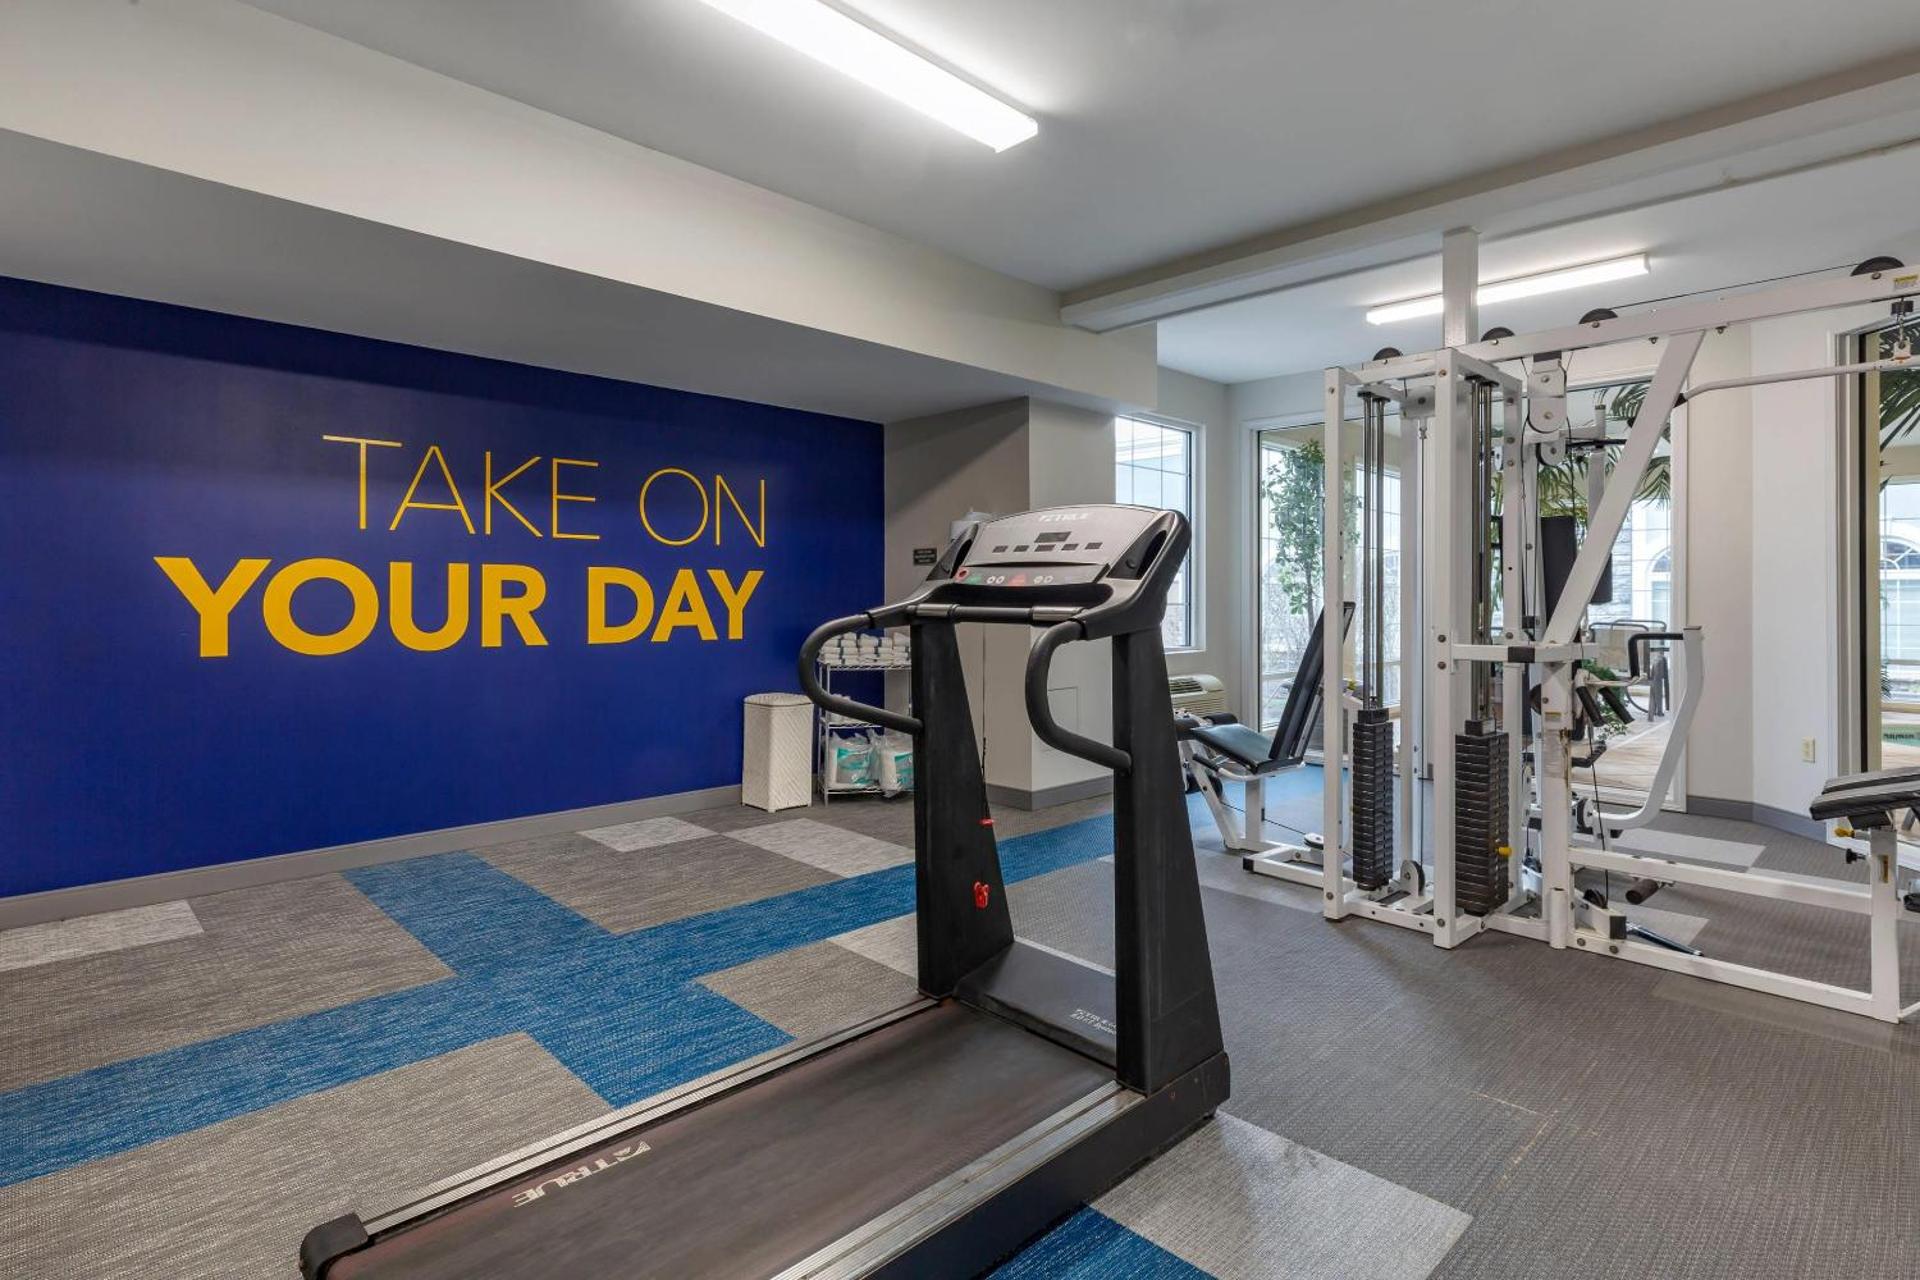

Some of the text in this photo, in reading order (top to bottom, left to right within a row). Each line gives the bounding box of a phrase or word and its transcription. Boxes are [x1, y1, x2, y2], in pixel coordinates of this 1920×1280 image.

[323, 434, 767, 548] TAKE ON
[153, 555, 764, 659] YOUR DAY
[512, 1157, 619, 1208] TRUE
